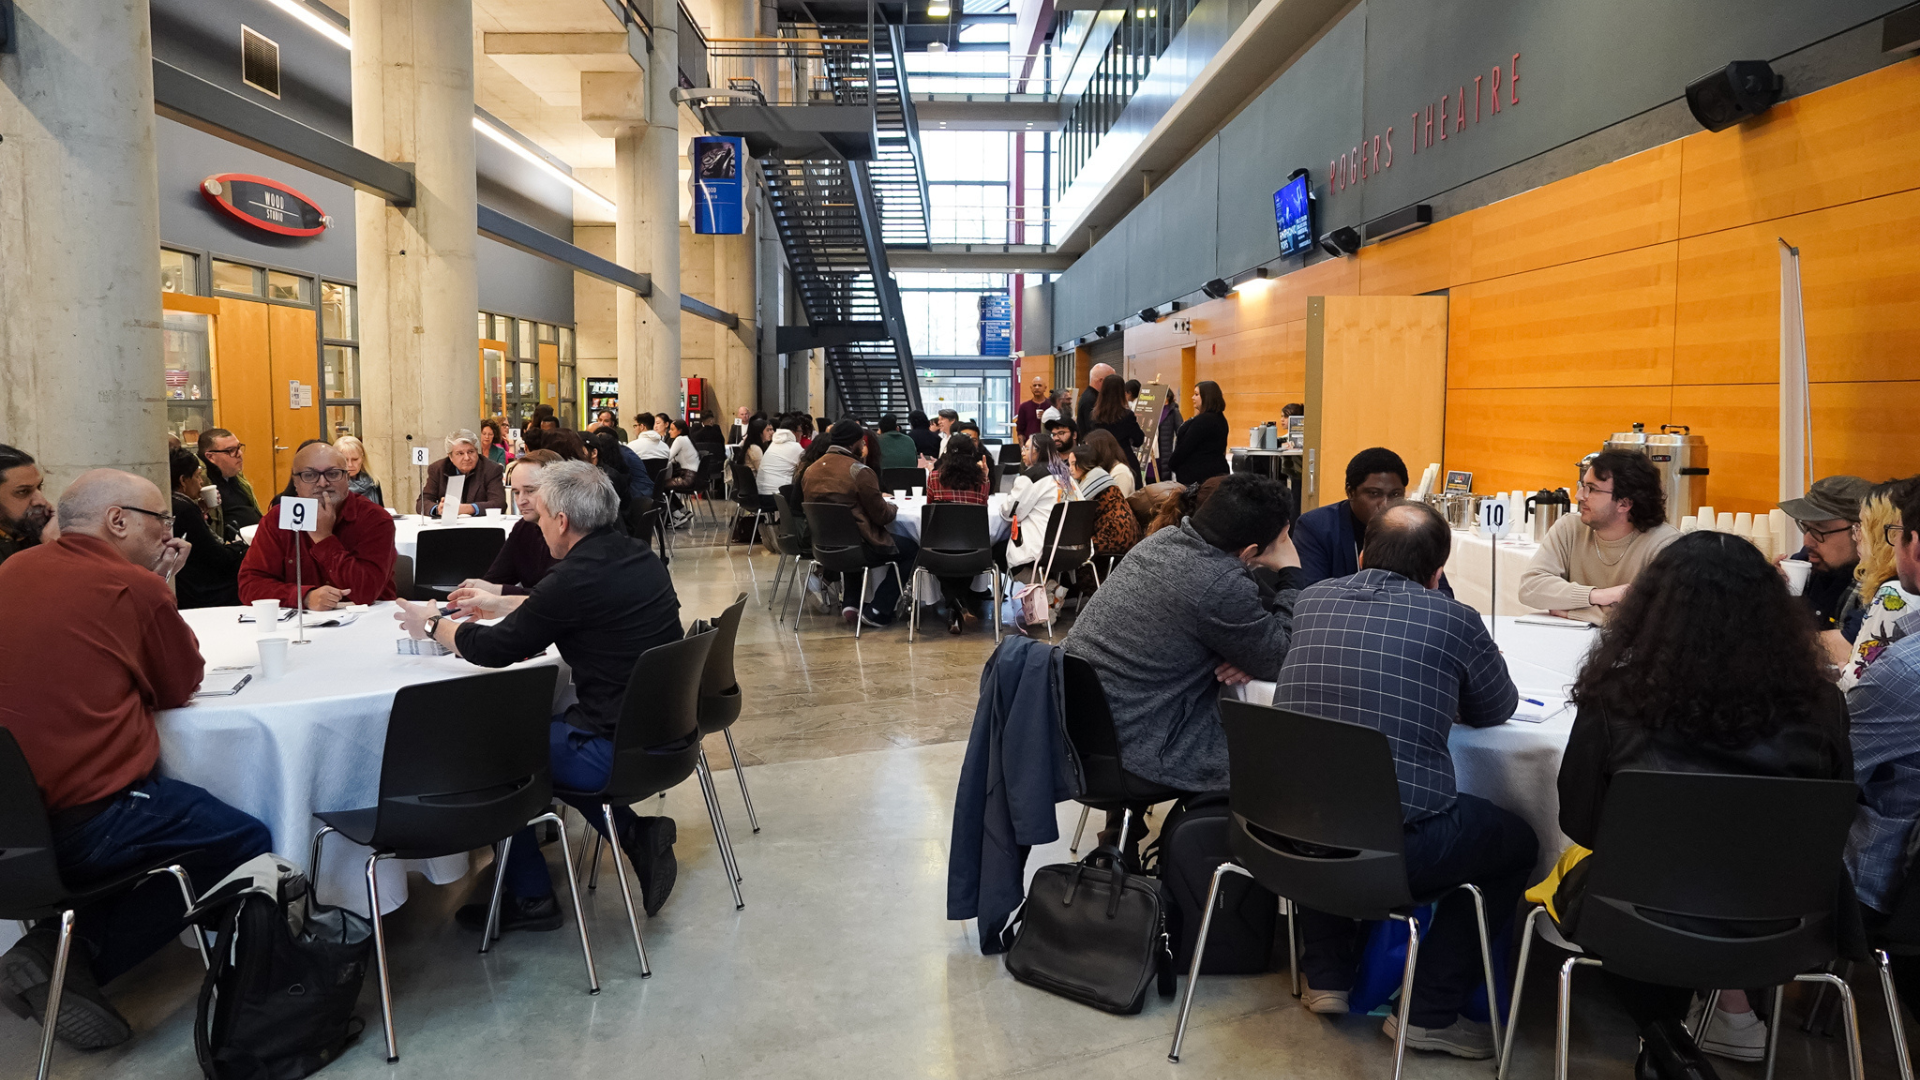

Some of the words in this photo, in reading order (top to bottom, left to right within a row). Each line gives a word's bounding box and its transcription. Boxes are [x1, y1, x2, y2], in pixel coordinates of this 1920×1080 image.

[1330, 127, 1393, 195] ROGERS
[1412, 52, 1520, 154] THEATRE
[264, 191, 285, 210] WOOD
[266, 209, 284, 222] STUDIO
[513, 430, 518, 438] 6
[417, 449, 424, 462] 8
[292, 502, 305, 525] 9
[1485, 504, 1504, 527] 10
